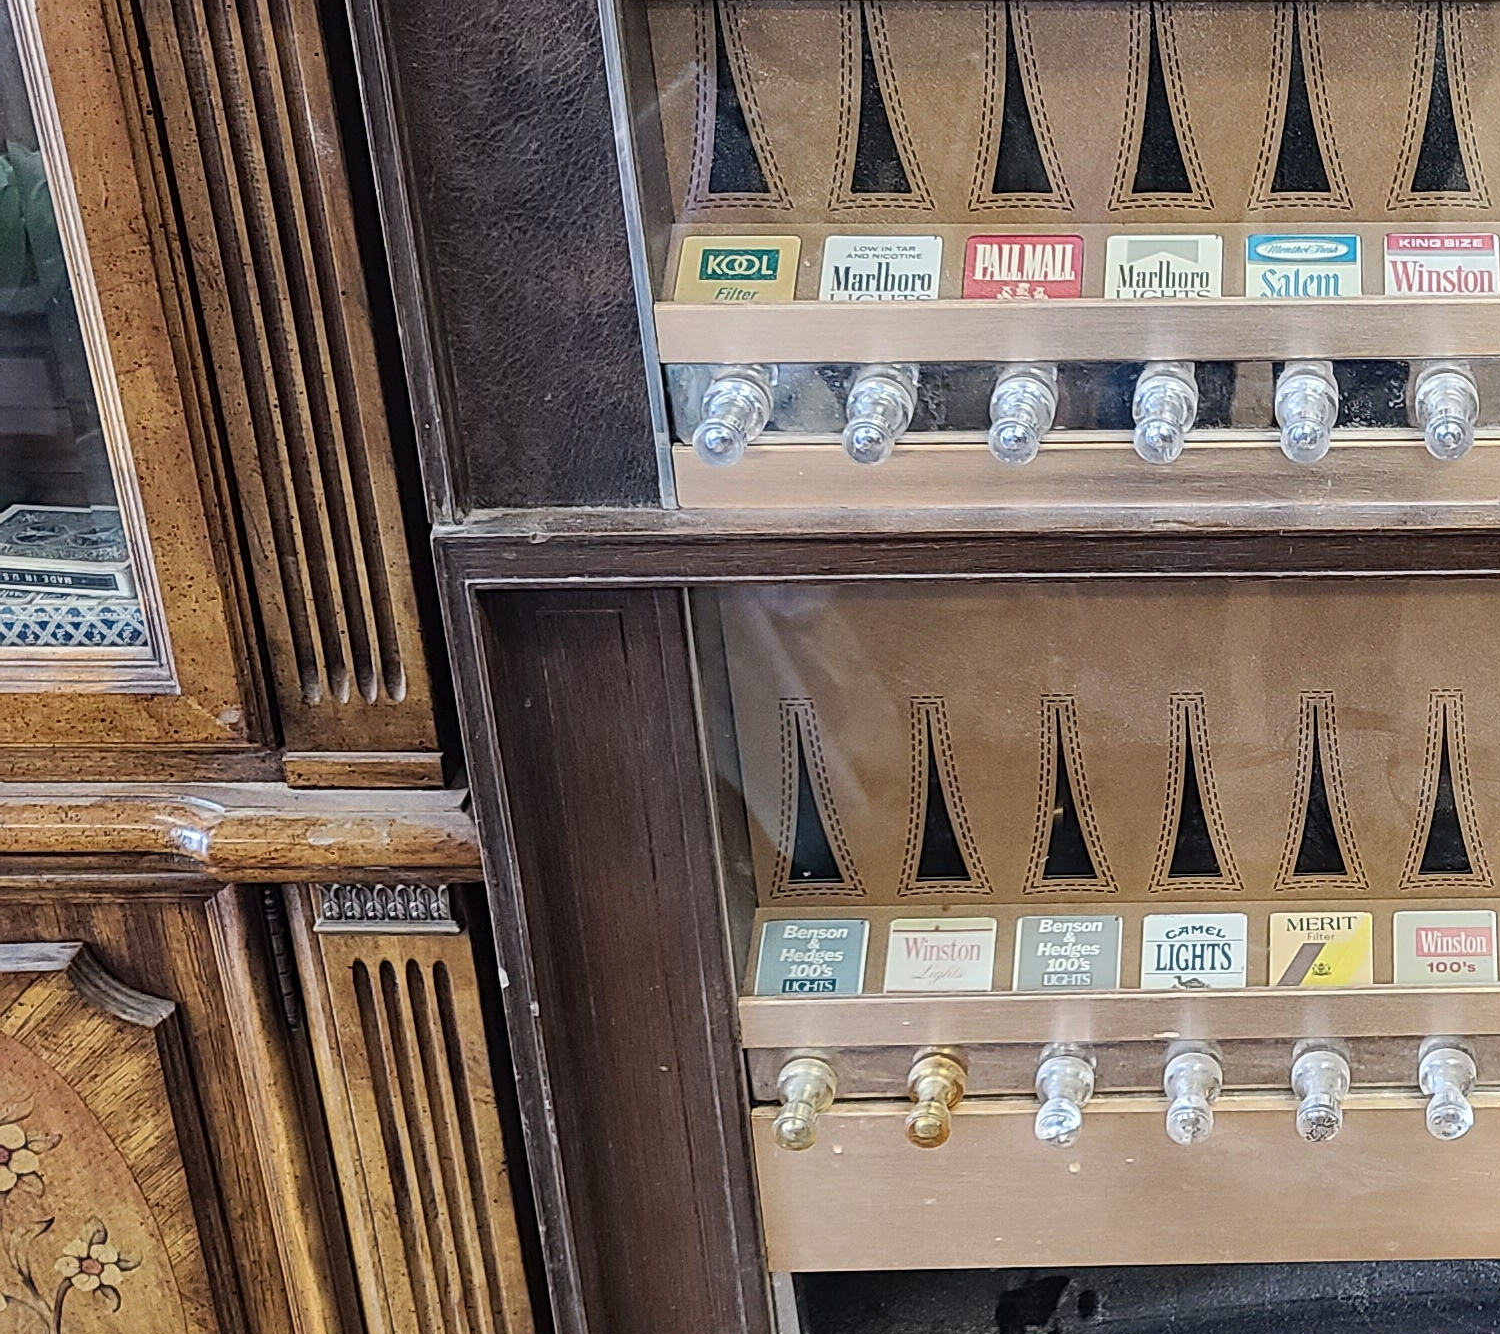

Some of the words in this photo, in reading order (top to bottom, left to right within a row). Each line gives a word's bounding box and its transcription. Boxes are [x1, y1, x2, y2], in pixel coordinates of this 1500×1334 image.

[1399, 238, 1442, 248] KING
[1444, 238, 1483, 248] SIZE
[706, 254, 776, 276] KOOL
[973, 244, 1021, 281] PALL
[1020, 244, 1075, 281] MALL
[831, 261, 932, 292] Marlboro
[1118, 260, 1210, 289] Marlboro
[1261, 267, 1342, 298] Salem
[1389, 260, 1494, 293] Winston
[715, 286, 759, 301] Filter
[25, 573, 37, 582] IN
[42, 574, 73, 585] MADE
[1038, 919, 1103, 934] Benson
[1165, 924, 1227, 940] CAMEL
[1286, 916, 1357, 932] MERIT
[782, 924, 848, 941] Benson
[1063, 931, 1077, 943] &
[1307, 932, 1336, 942] Filter
[807, 938, 821, 950] &
[903, 936, 982, 962] Winston
[1036, 942, 1101, 958] Hedges
[1420, 929, 1487, 955] Winston
[779, 947, 844, 963] Hedges
[1154, 942, 1233, 971] LIGHTS
[788, 963, 834, 978] 100's
[1046, 957, 1091, 972] 100's
[1426, 961, 1477, 973] 100's
[914, 964, 964, 982] Lights
[1042, 972, 1092, 986] LIGHTS
[784, 979, 836, 993] LIGHTS
